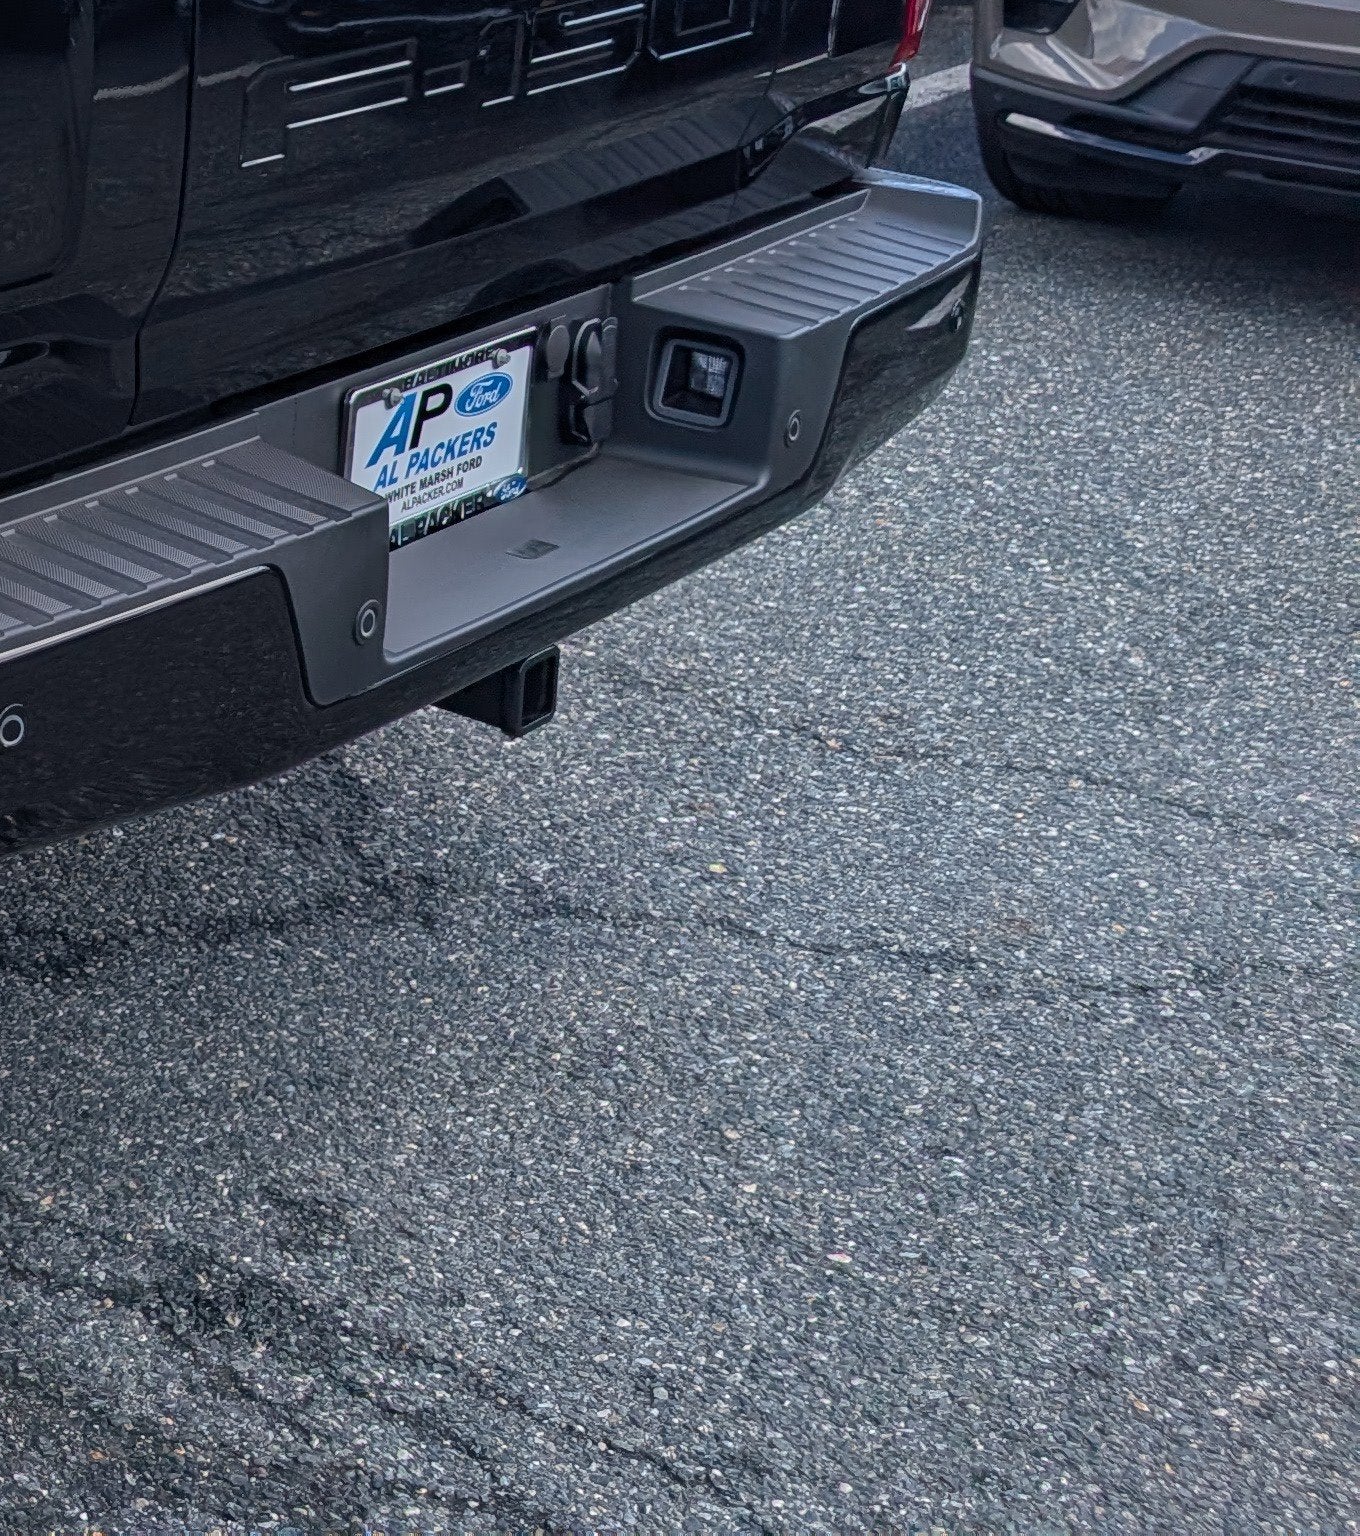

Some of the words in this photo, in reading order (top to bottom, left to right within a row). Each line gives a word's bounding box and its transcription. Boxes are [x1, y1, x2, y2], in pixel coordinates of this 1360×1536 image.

[465, 378, 502, 412] Ford
[364, 382, 453, 469] AP
[373, 459, 399, 492] AL
[404, 421, 498, 480] PACKERS
[383, 482, 417, 503] WHITE
[418, 466, 454, 492] MARSH
[456, 455, 483, 474] FORD
[400, 477, 464, 514] ALPACKER.COM
